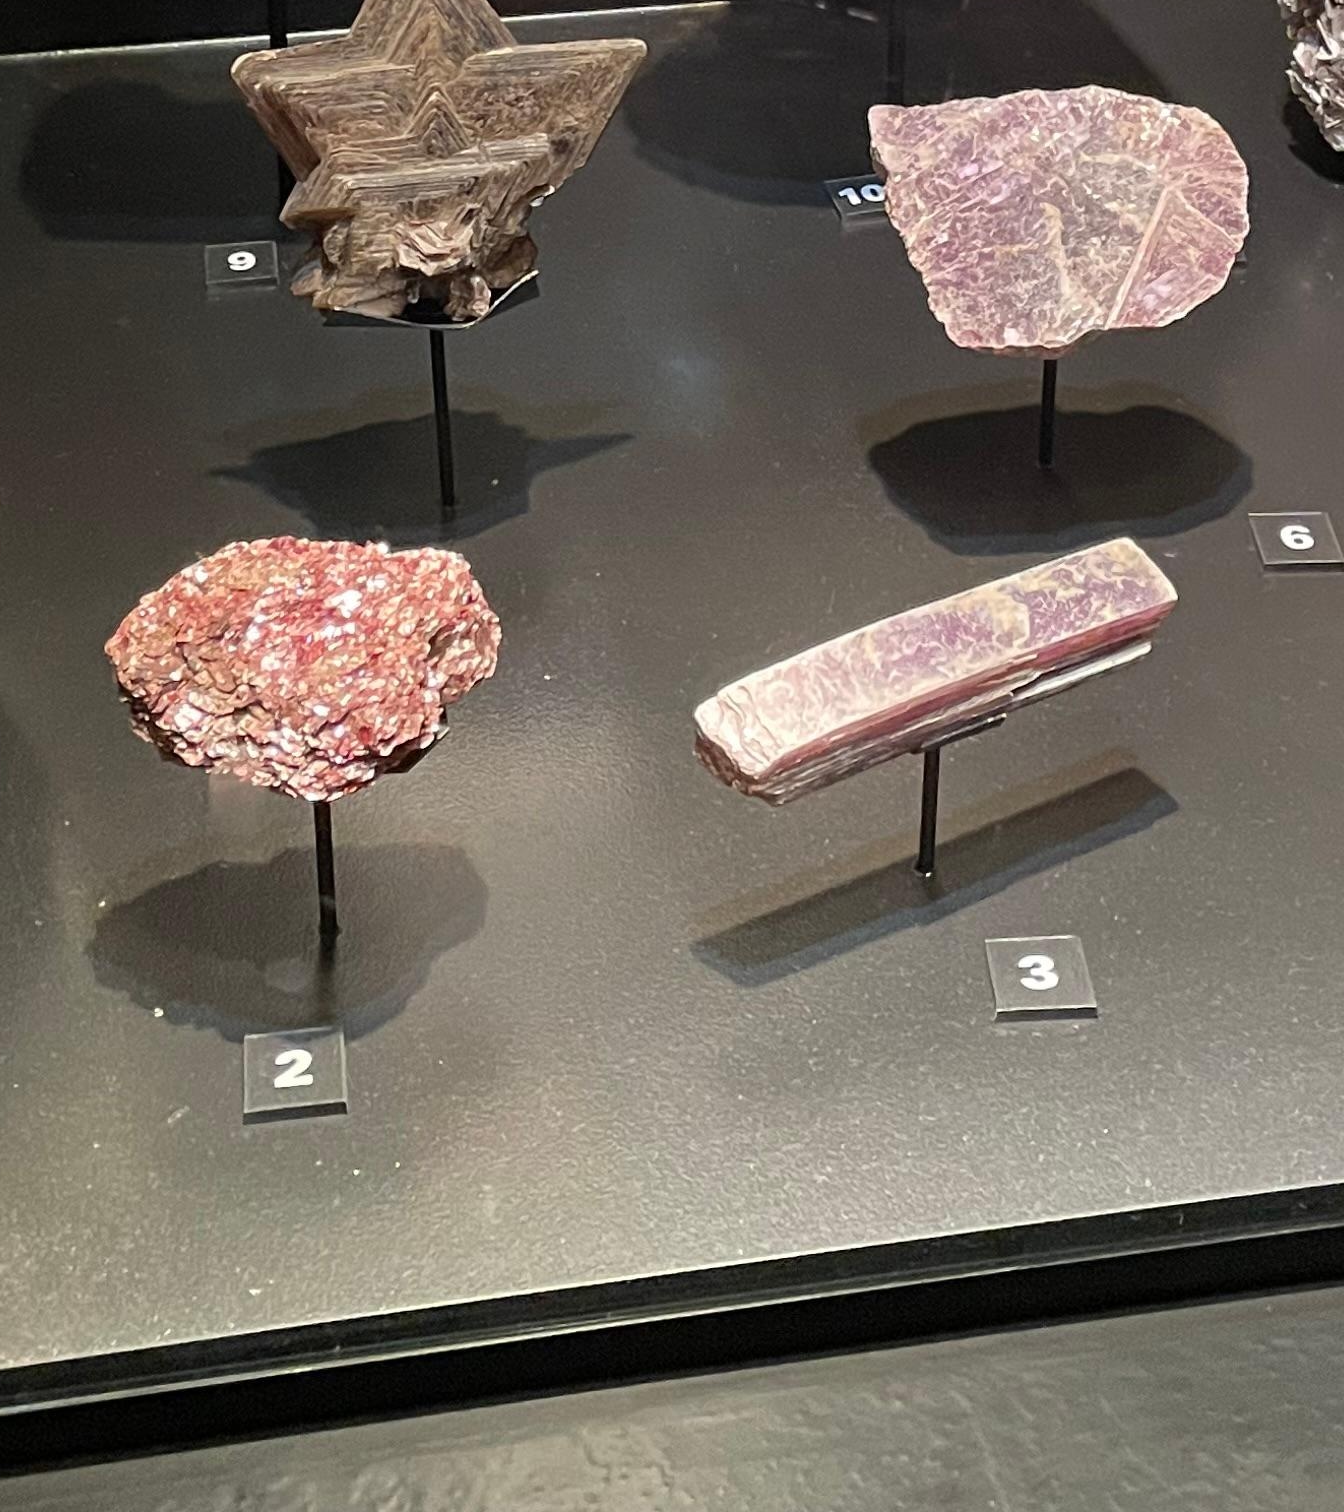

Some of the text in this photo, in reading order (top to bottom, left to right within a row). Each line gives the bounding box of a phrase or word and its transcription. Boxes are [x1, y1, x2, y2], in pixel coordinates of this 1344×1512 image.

[839, 184, 886, 206] 10
[228, 251, 256, 271] 9
[1280, 525, 1315, 550] 6
[1017, 954, 1058, 990] 3
[273, 1048, 314, 1088] 2
